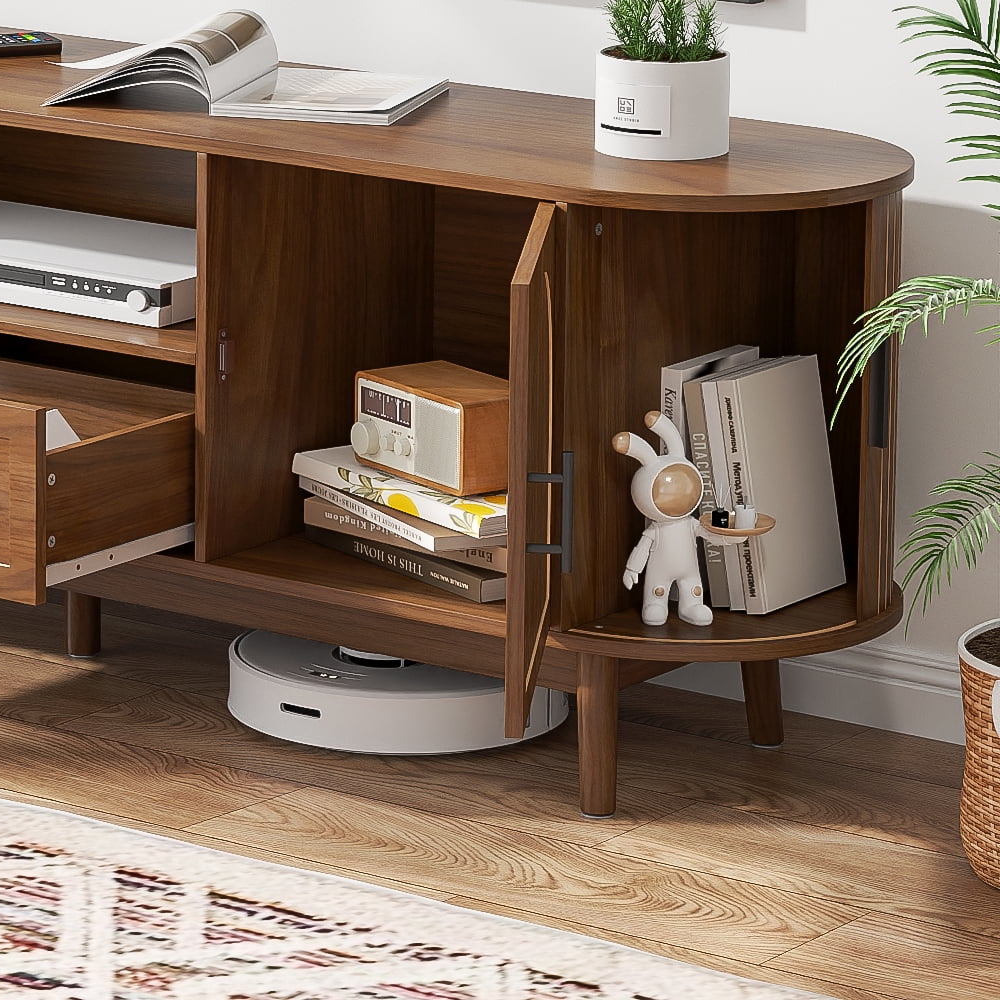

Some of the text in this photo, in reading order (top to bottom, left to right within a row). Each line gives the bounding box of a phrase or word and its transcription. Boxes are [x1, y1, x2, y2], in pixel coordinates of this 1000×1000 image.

[692, 433, 713, 496] СПАСИТЕ
[732, 462, 742, 490] Метод
[324, 511, 367, 530] Kingdom
[352, 540, 385, 562] HOME
[387, 553, 397, 570] IS
[399, 557, 424, 577] THIS
